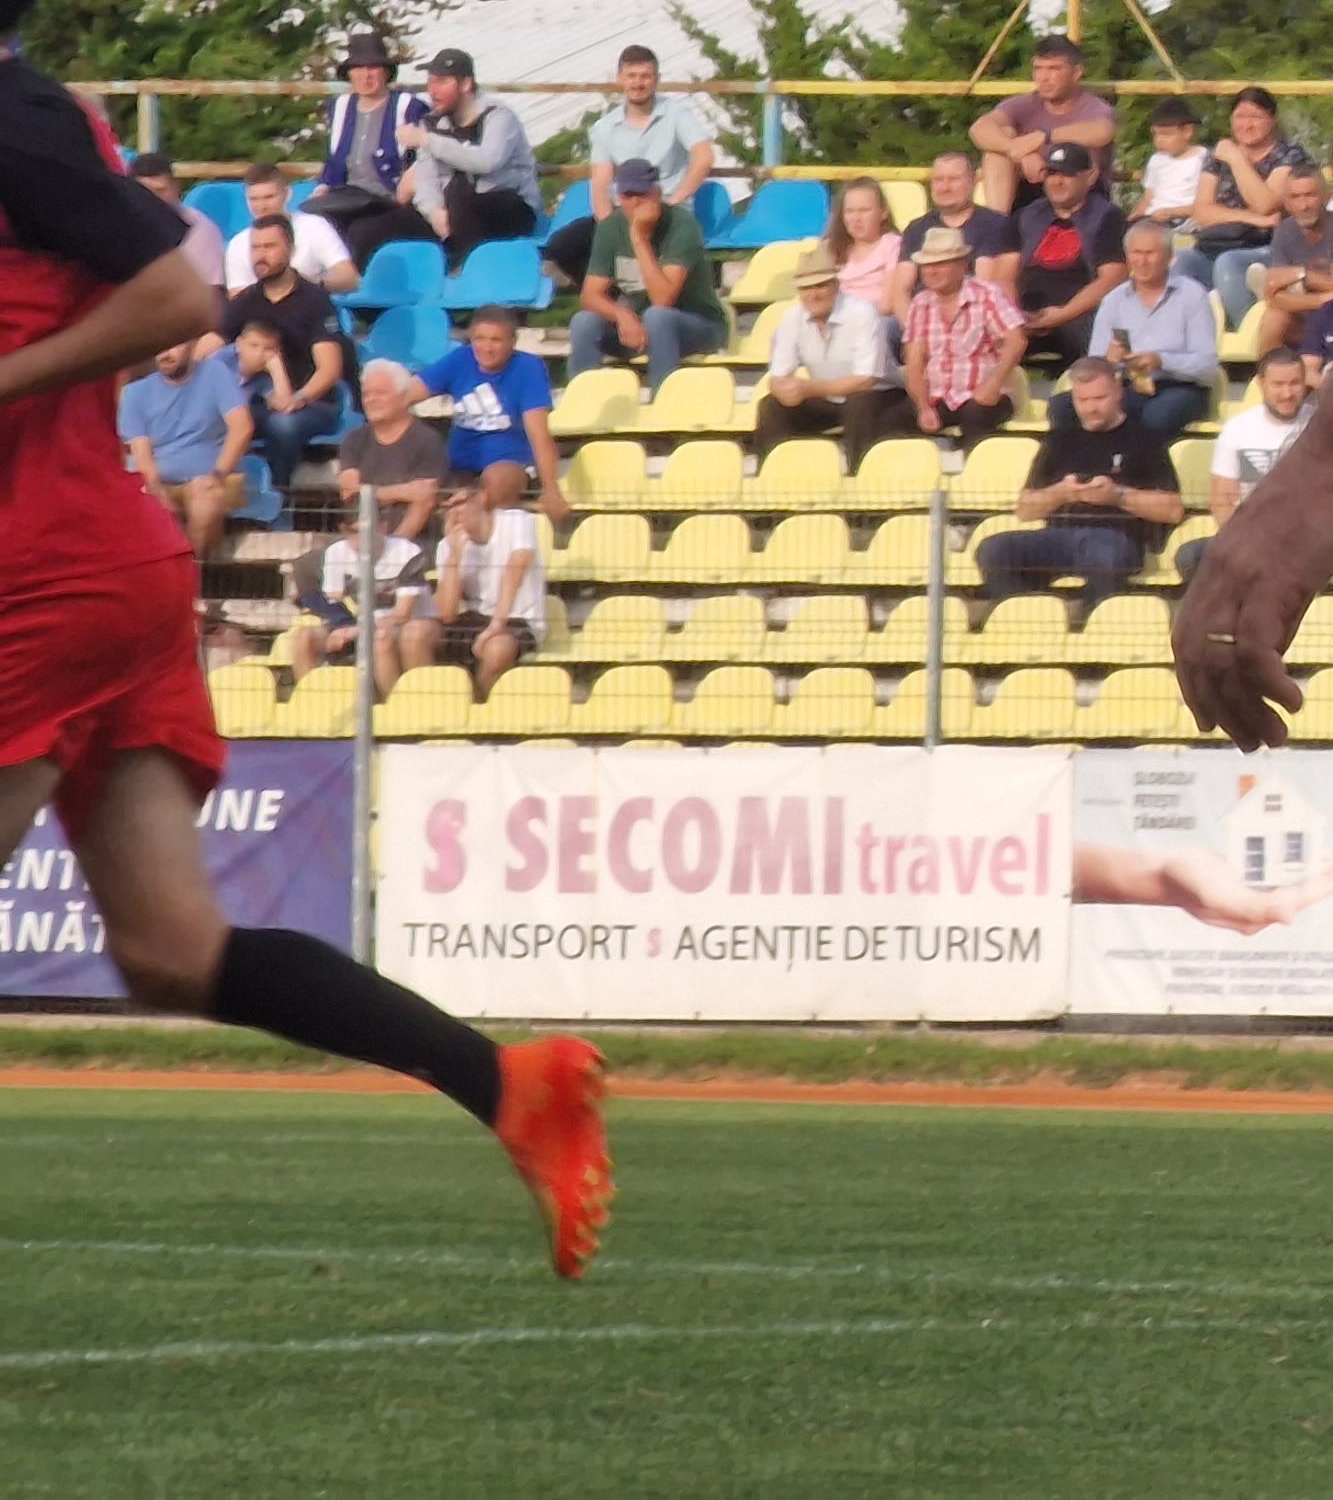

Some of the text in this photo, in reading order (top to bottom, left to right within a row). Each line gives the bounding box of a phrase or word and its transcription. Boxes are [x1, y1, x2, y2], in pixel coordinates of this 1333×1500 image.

[401, 922, 638, 961] TRANSPORT
[673, 924, 834, 973] AGENȚIE
[844, 926, 889, 961] DE
[893, 926, 1042, 964] TURISM
